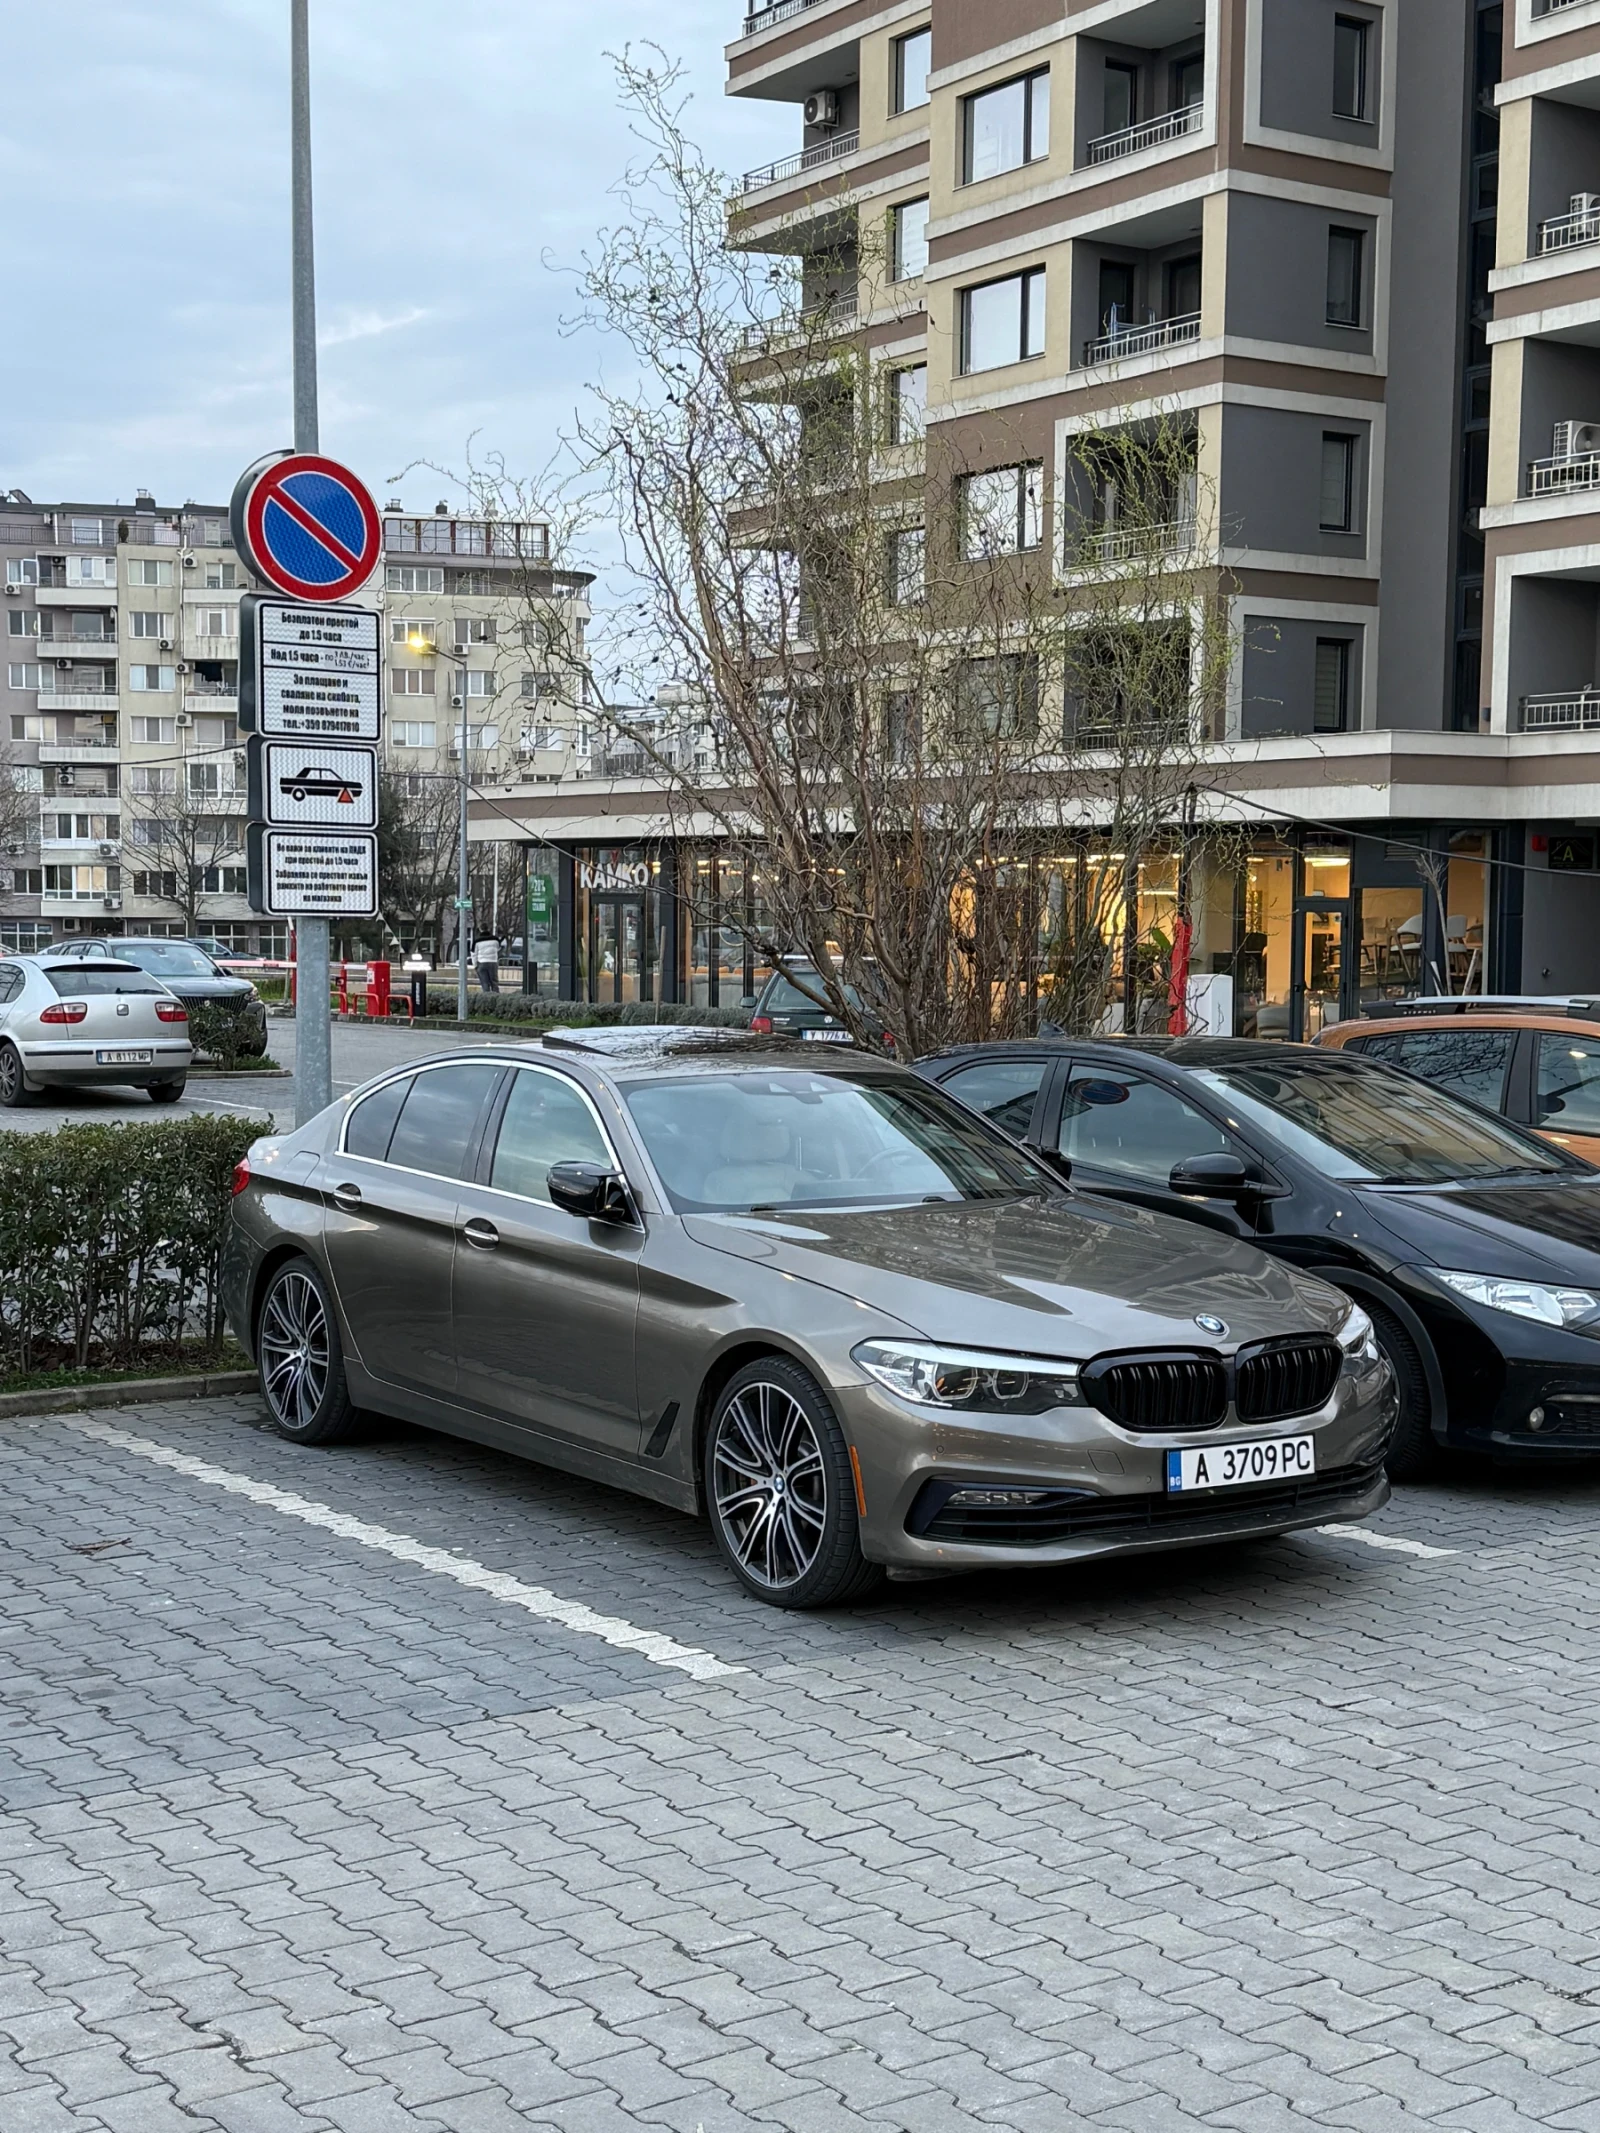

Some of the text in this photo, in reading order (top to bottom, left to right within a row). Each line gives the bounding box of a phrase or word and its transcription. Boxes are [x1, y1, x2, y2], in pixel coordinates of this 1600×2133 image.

[281, 611, 360, 629] Безплатен престой
[299, 630, 311, 641] до
[323, 632, 342, 642] часа
[270, 648, 288, 662] Над
[300, 653, 320, 663] часа
[293, 673, 348, 688] За плащане и
[281, 689, 315, 700] сваляне
[316, 692, 326, 701] на
[283, 704, 359, 718] моля позвънете на
[580, 862, 649, 889] KAMKO
[1195, 1453, 1210, 1484] A
[1170, 1476, 1181, 1487] BG
